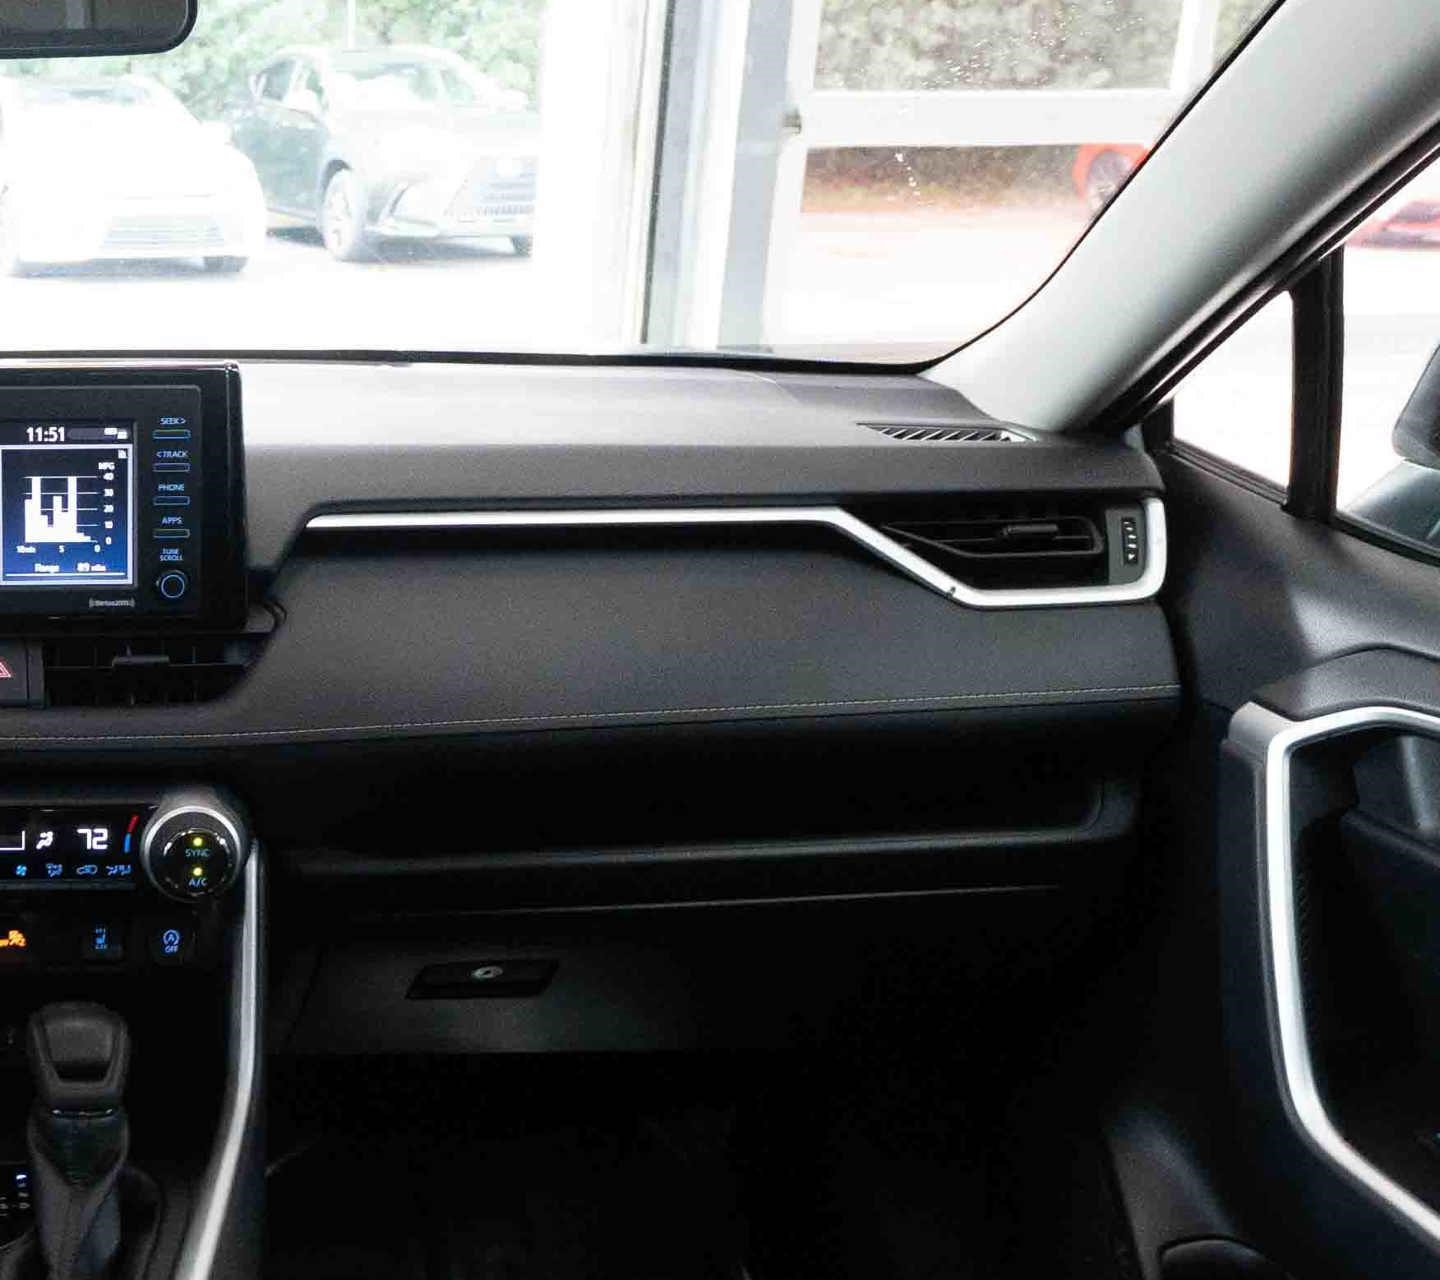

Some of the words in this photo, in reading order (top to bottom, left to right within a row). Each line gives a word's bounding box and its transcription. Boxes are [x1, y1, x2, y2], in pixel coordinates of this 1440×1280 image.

[25, 426, 66, 442] 11:51
[98, 462, 115, 470] MPG
[103, 473, 114, 481] 40
[158, 483, 185, 491] PHONE
[104, 489, 114, 497] 30
[103, 505, 114, 513] 20
[104, 521, 114, 529] 10
[161, 517, 183, 525] APPS
[105, 536, 112, 545] 0
[58, 544, 65, 553] 5
[94, 544, 101, 553] 0
[77, 828, 109, 850] 72
[185, 848, 211, 857] SYNC
[188, 877, 208, 888] A/C
[164, 945, 180, 953] OFF
